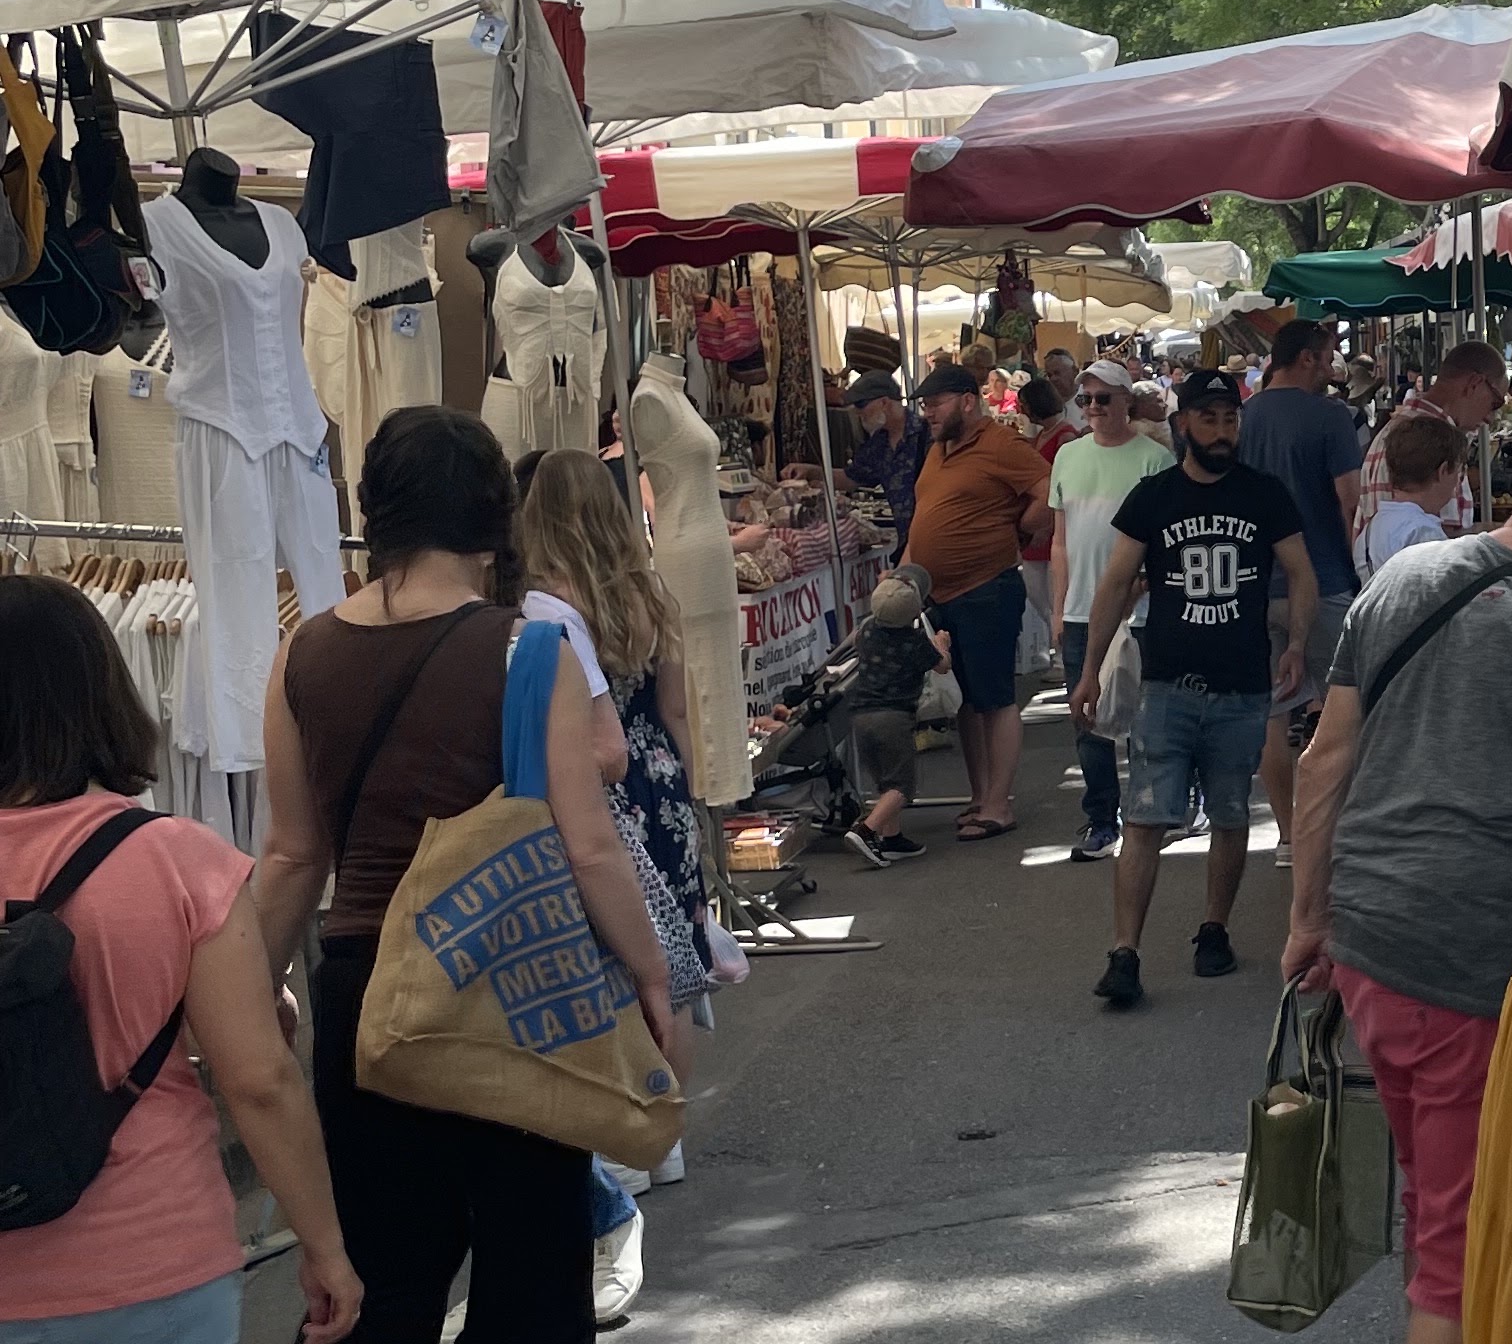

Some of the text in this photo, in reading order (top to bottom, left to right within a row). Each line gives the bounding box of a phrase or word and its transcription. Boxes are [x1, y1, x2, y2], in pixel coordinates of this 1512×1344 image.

[1162, 515, 1257, 548] ATHLETIC
[1180, 542, 1240, 599] 80
[1181, 598, 1240, 625] INOUT
[481, 887, 586, 957] VOTRE
[515, 1008, 567, 1050] LA
